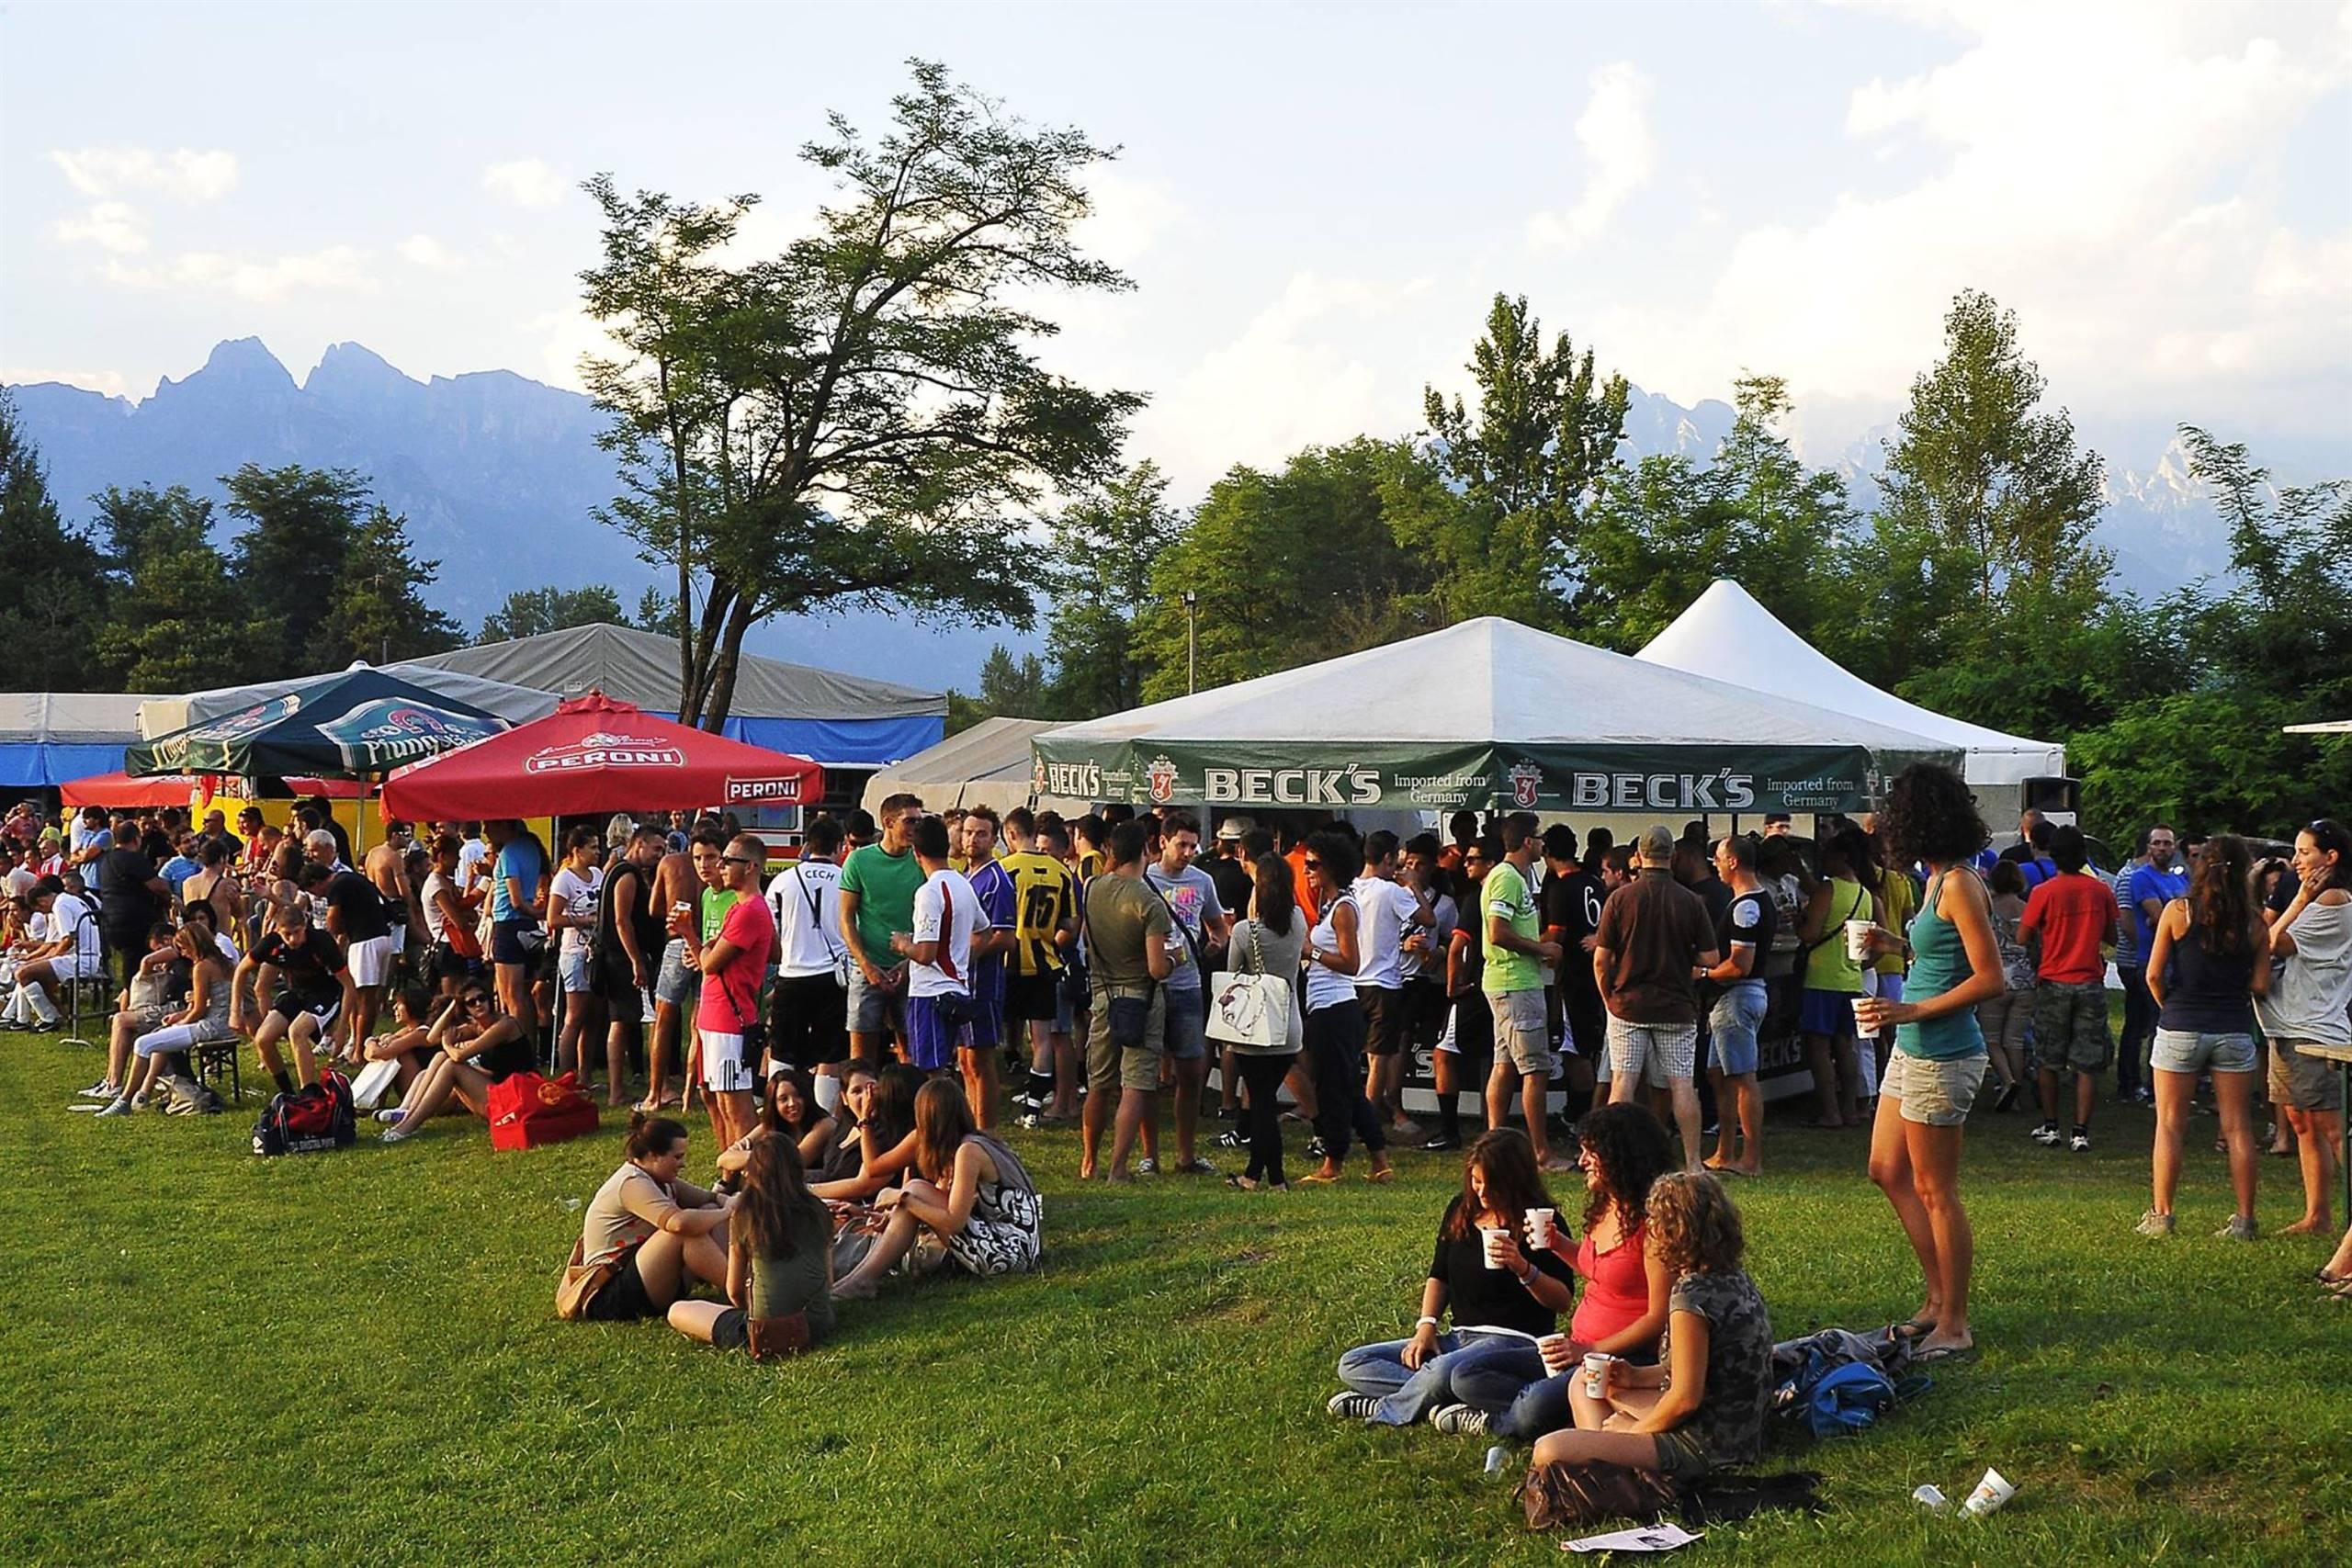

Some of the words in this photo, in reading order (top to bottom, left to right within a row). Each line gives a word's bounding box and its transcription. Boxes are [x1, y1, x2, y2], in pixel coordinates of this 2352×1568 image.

[537, 751, 673, 769] PERONI
[1394, 773, 1452, 790] Imported
[1455, 773, 1487, 786] from
[1767, 778, 1824, 794] Imported
[1826, 778, 1854, 791] from
[730, 782, 796, 798] PERONI
[1410, 790, 1469, 806] Germany
[1783, 794, 1838, 809] Germany
[805, 869, 835, 882] CECH
[1023, 884, 1057, 930] 15
[1584, 886, 1601, 928] 6
[1759, 1030, 1802, 1070] ECK'S
